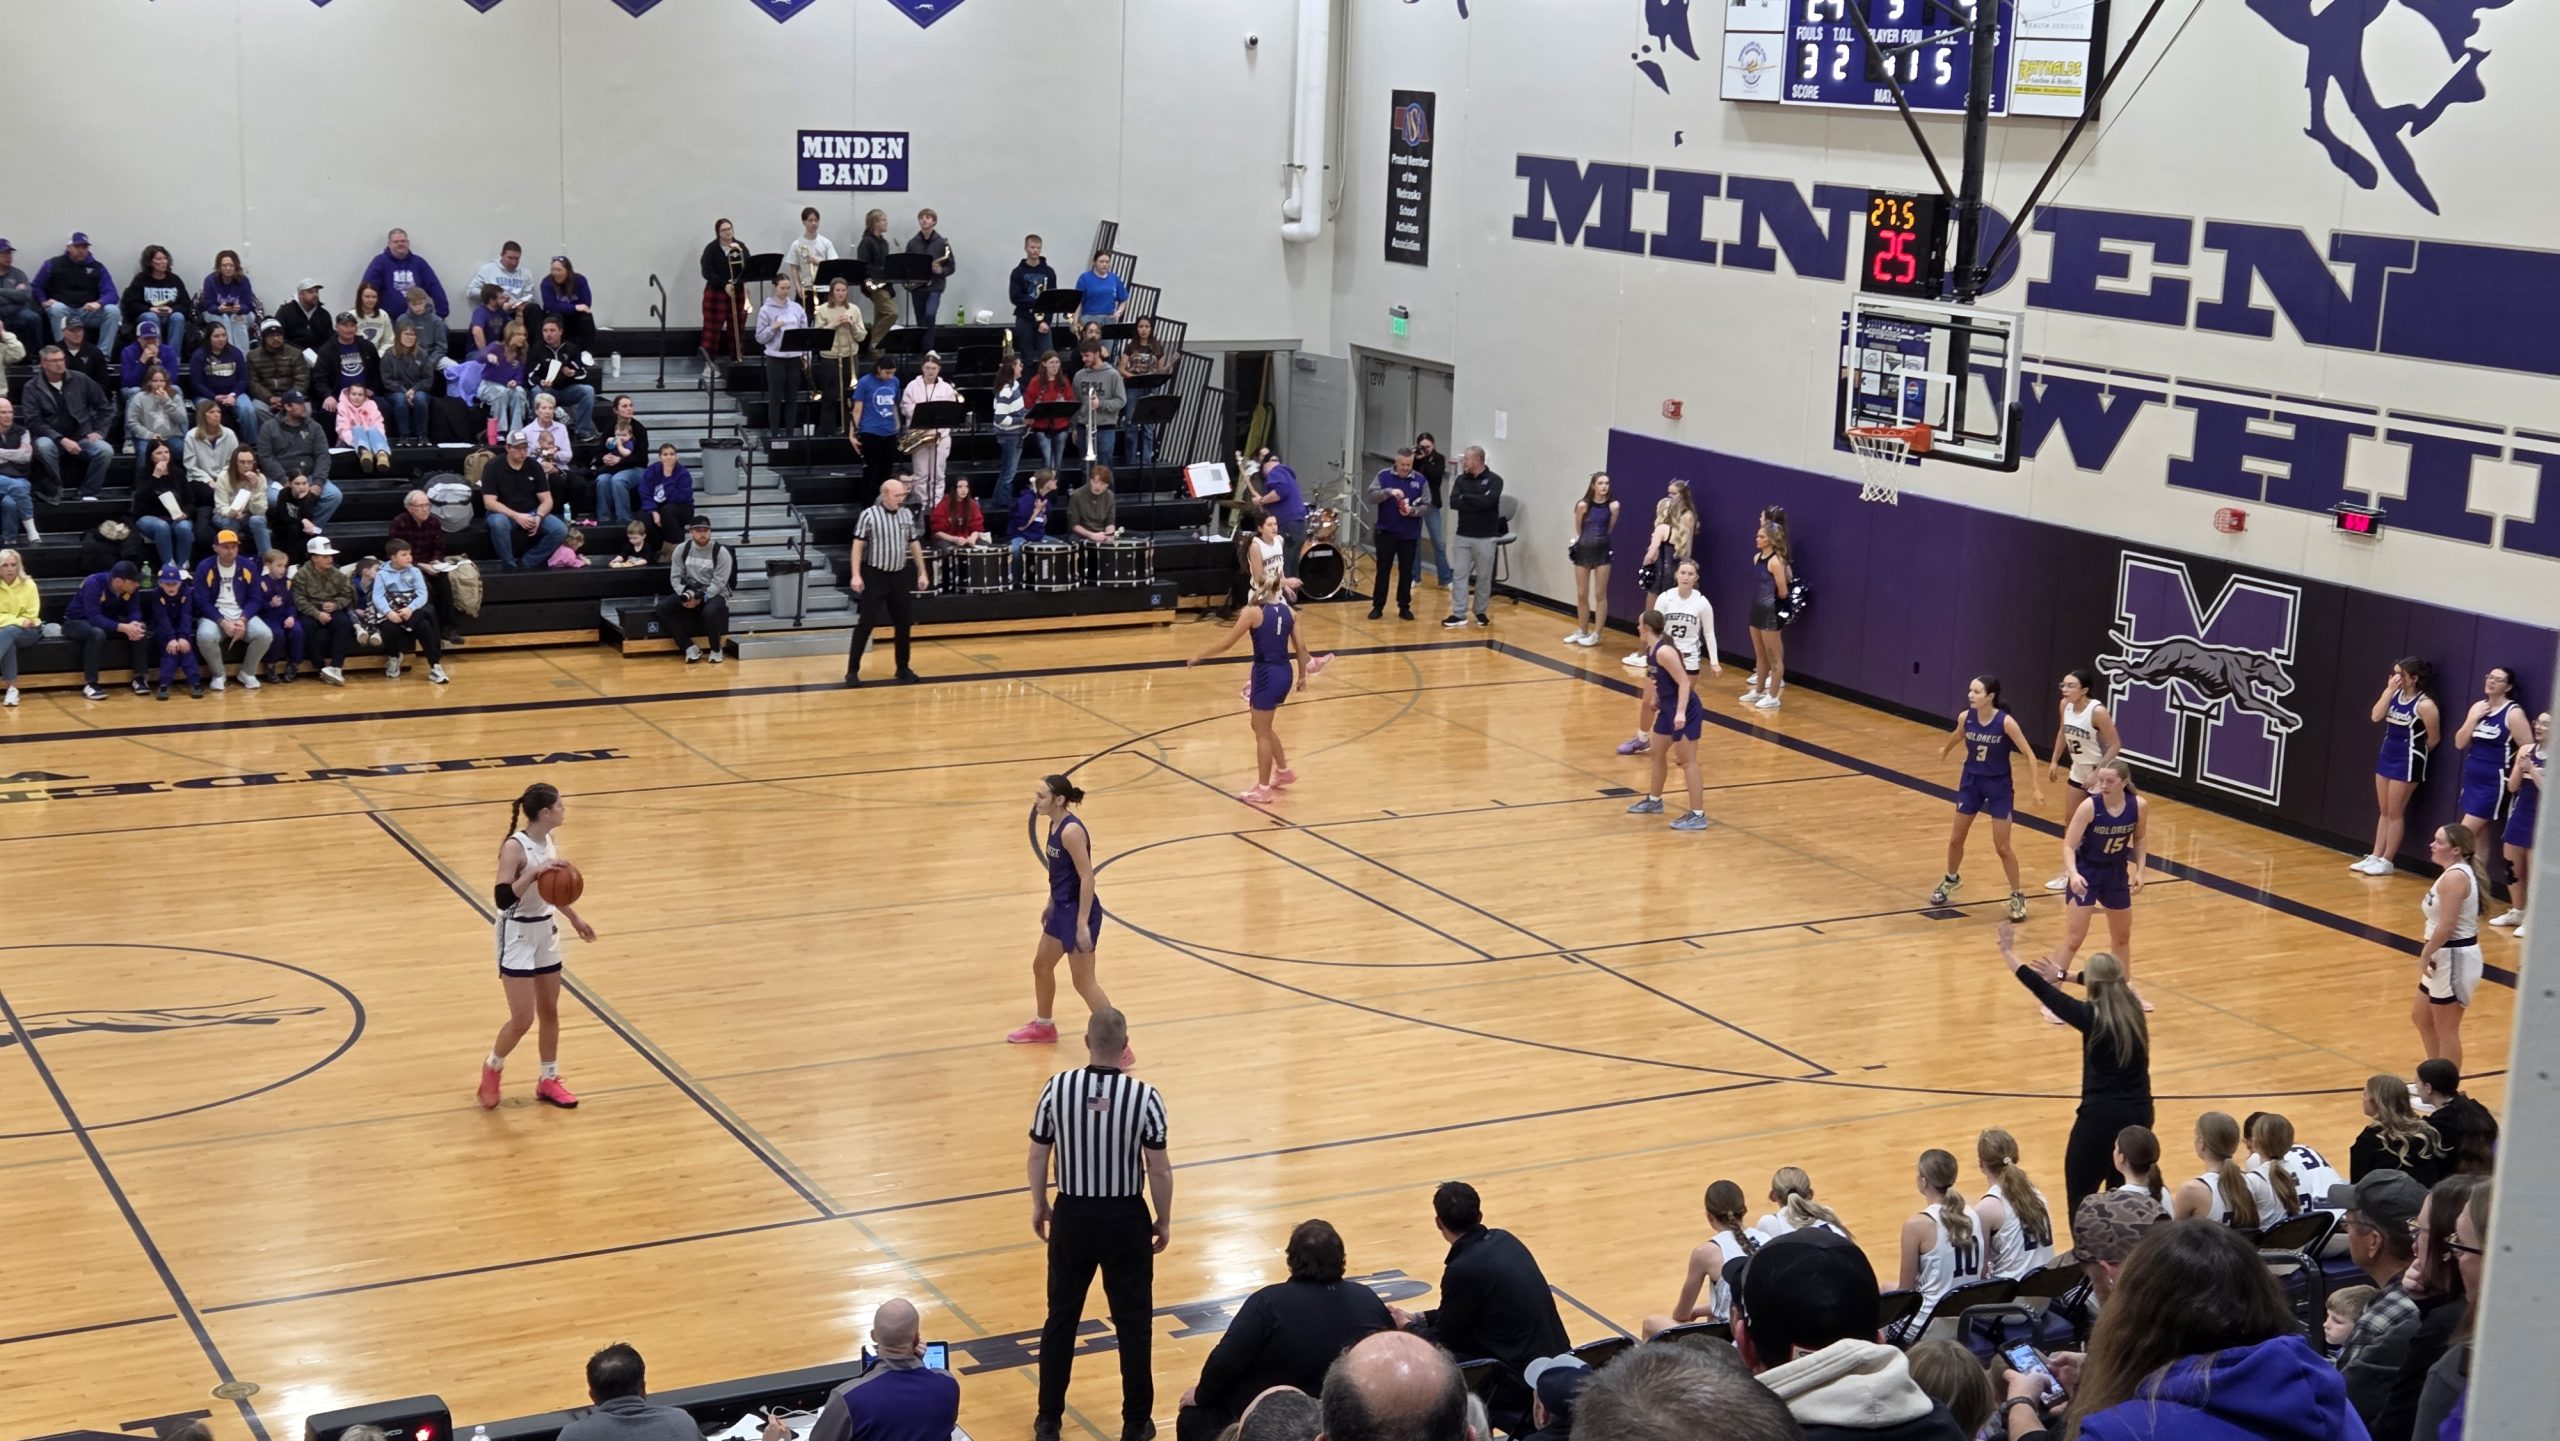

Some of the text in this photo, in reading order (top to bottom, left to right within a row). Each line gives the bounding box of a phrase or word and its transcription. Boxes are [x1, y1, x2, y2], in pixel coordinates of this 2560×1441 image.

[1796, 26, 1823, 41] FOULS
[1803, 43, 1819, 79] 3
[1832, 44, 1850, 80] 2
[1935, 47, 1952, 85] 5
[1791, 84, 1820, 99] SCORE
[802, 136, 904, 159] MINDEN
[1391, 154, 1430, 168] Proud Member
[819, 163, 888, 186] BAND
[1407, 173, 1418, 184] the
[1396, 188, 1421, 201] Nebraska
[1399, 204, 1417, 217] School
[1871, 198, 1915, 229] 27.5
[1395, 221, 1419, 234] Activities
[1391, 237, 1421, 251] Association
[1873, 230, 1916, 283] 25
[1276, 616, 1283, 636] 1
[1671, 624, 1687, 639] 23
[1976, 745, 1988, 762] 3
[2103, 836, 2126, 854] 15
